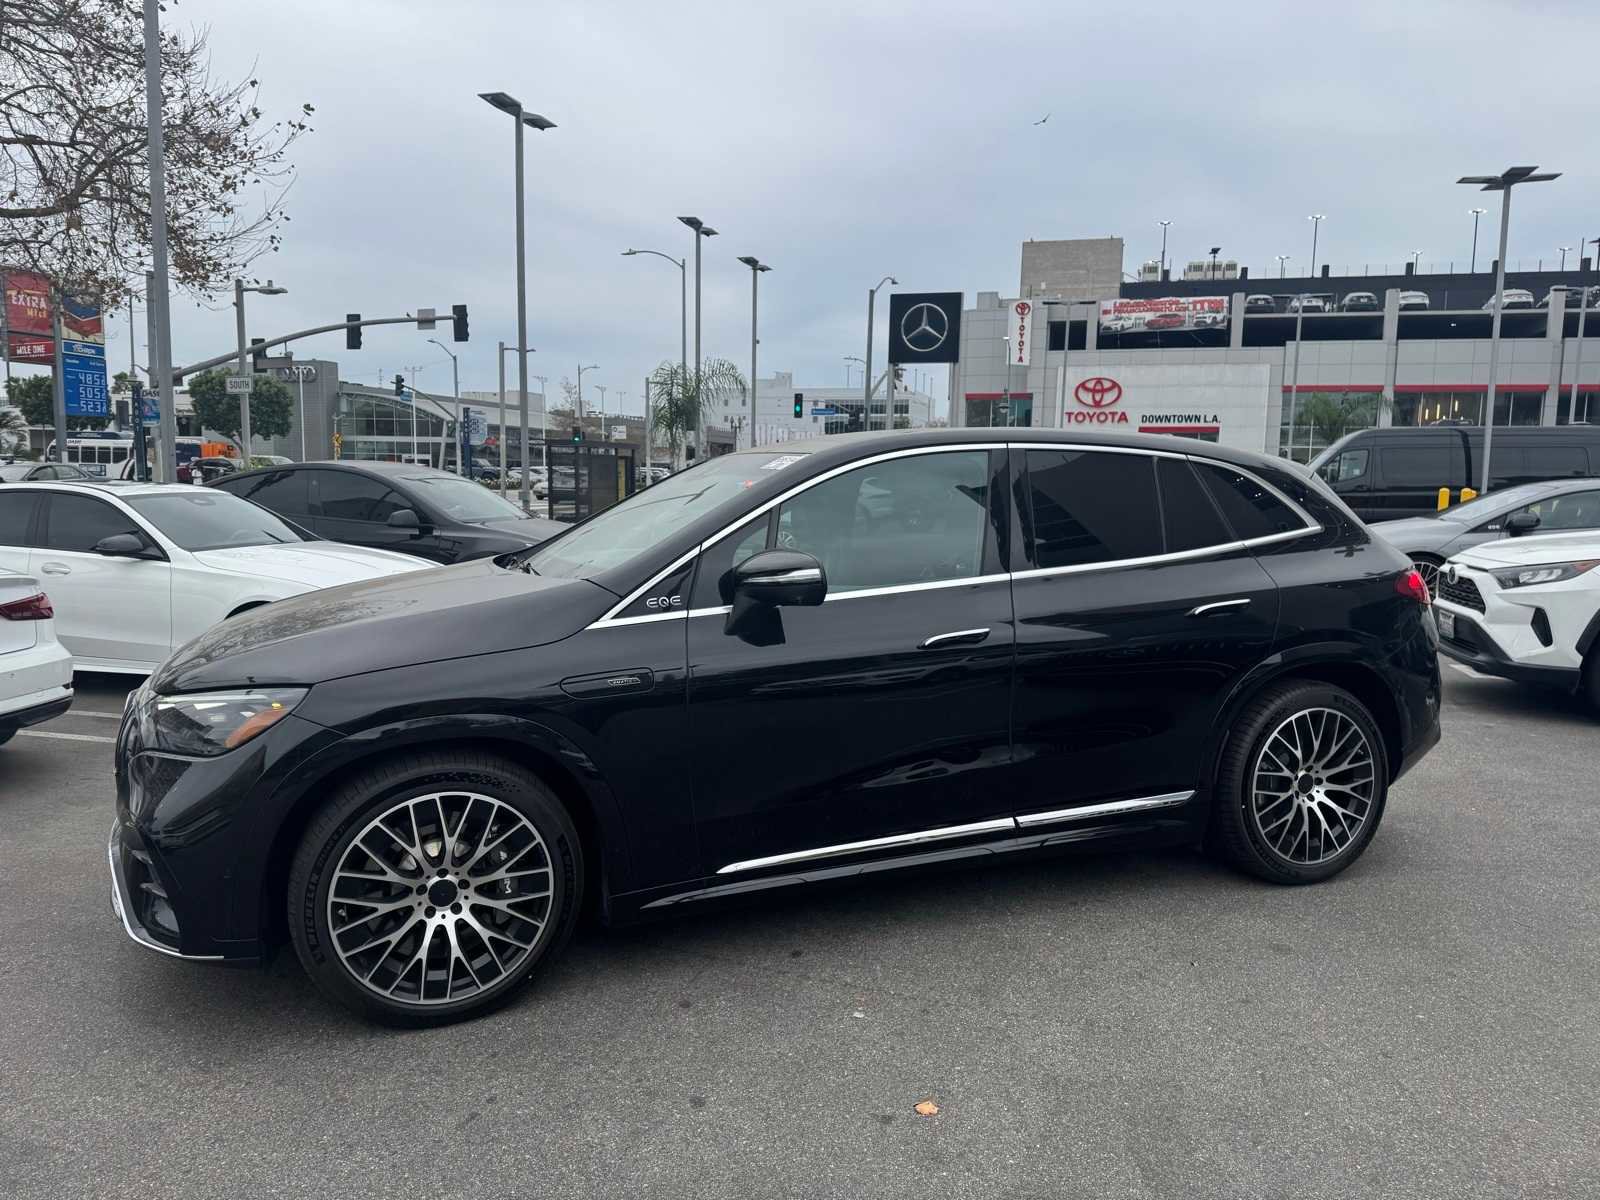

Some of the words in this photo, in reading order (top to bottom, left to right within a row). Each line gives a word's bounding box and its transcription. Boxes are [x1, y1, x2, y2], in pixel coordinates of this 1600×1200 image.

[11, 293, 48, 309] EXTRA
[1017, 316, 1025, 363] TOYOTA
[229, 380, 250, 390] SOUTH
[1065, 411, 1129, 424] TOYOTA
[1141, 414, 1201, 424] DOWNTOWN
[1203, 414, 1222, 424] L.A.
[646, 595, 682, 608] EQE
